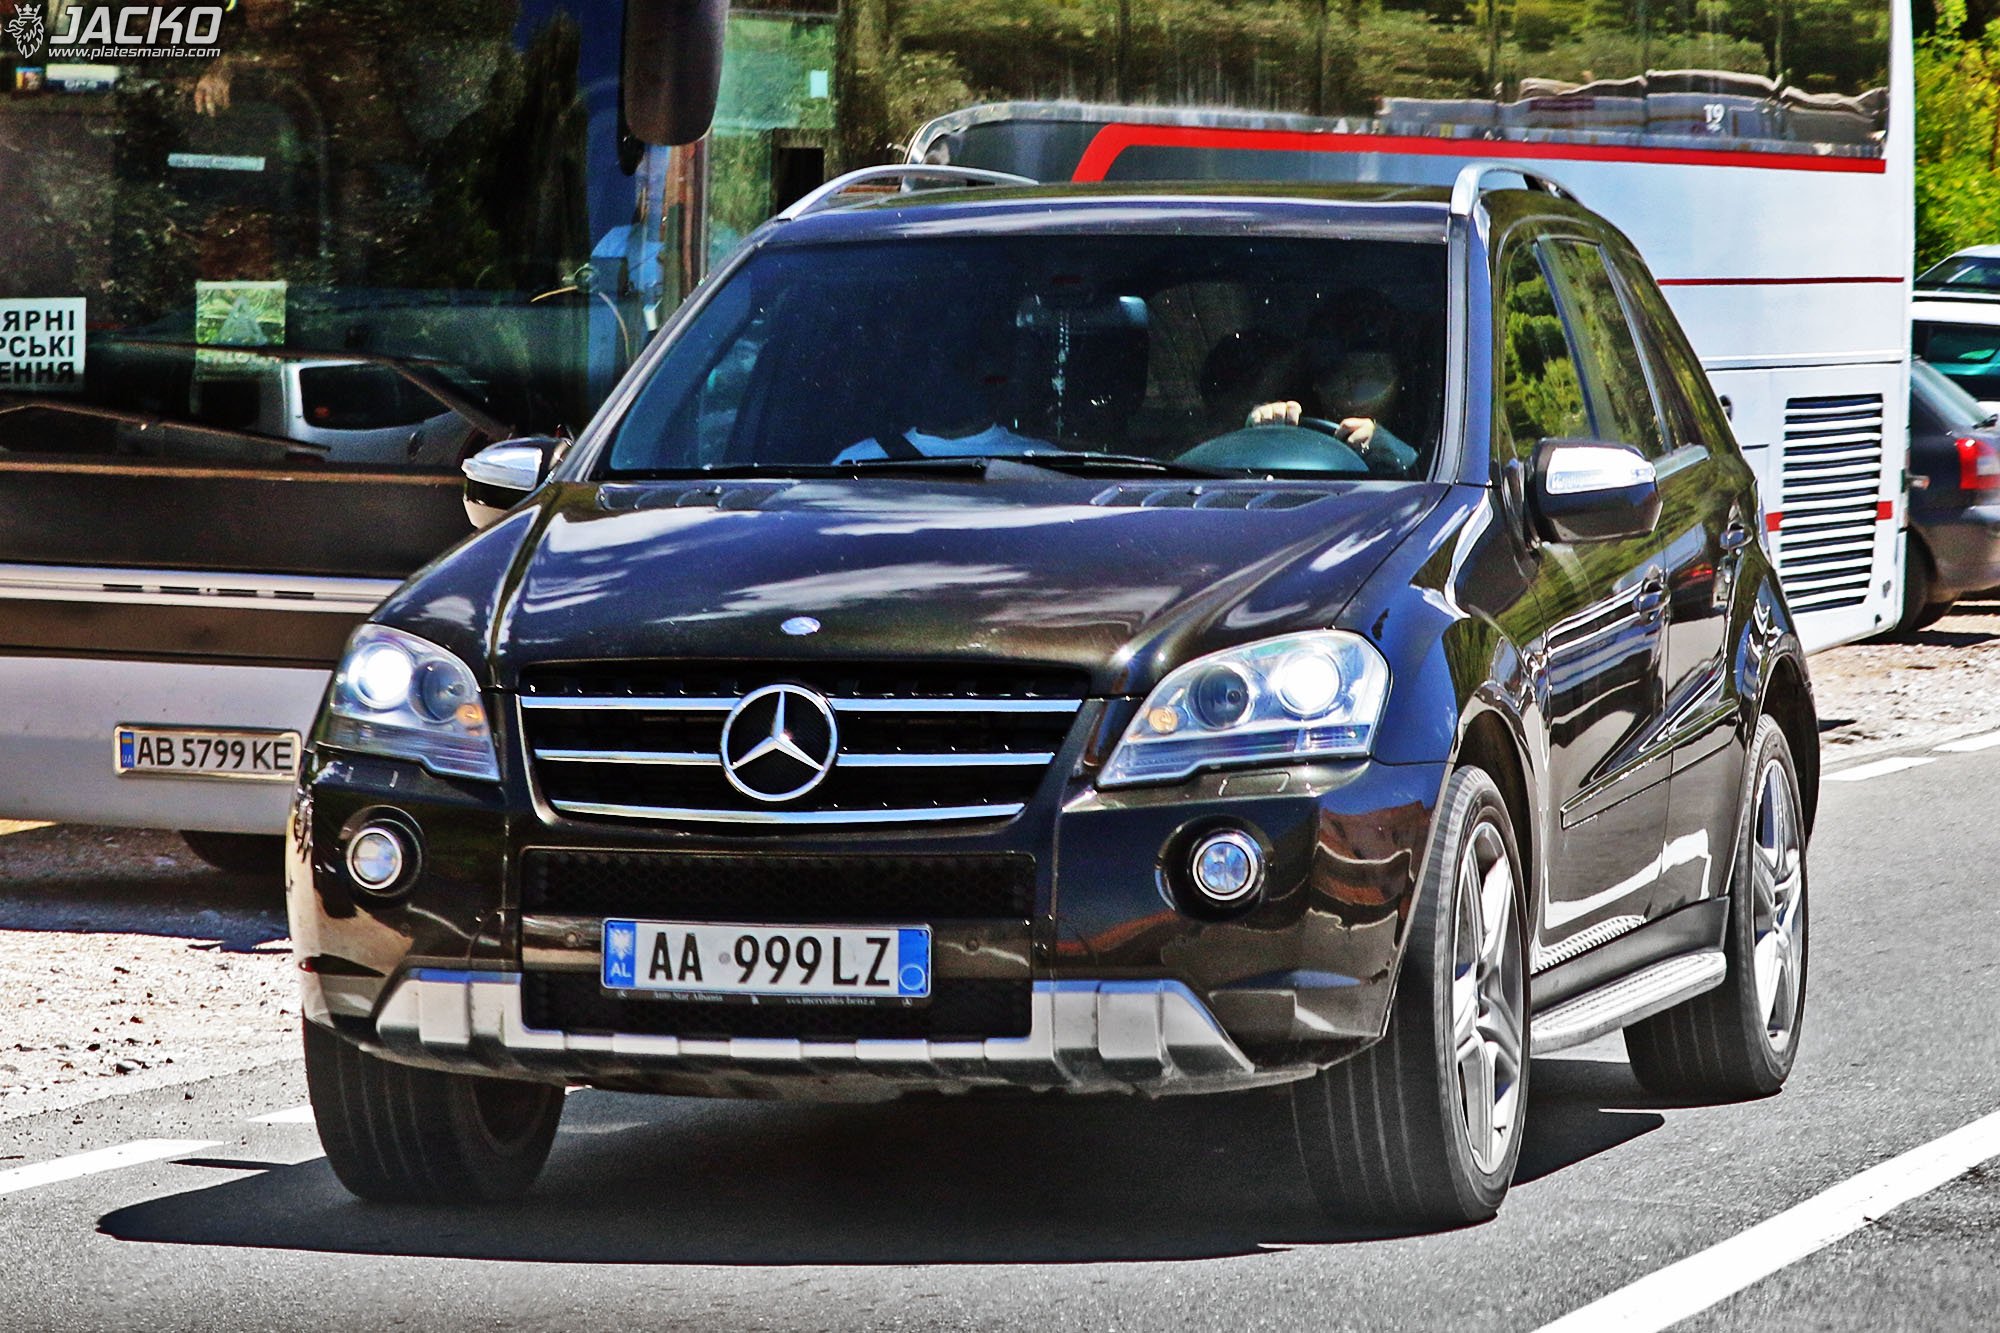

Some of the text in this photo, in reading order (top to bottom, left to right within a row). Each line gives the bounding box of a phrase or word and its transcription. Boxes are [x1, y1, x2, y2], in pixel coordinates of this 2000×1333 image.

[137, 736, 293, 770] AB 5799 KE
[610, 962, 632, 978] AL
[648, 931, 703, 982] AA
